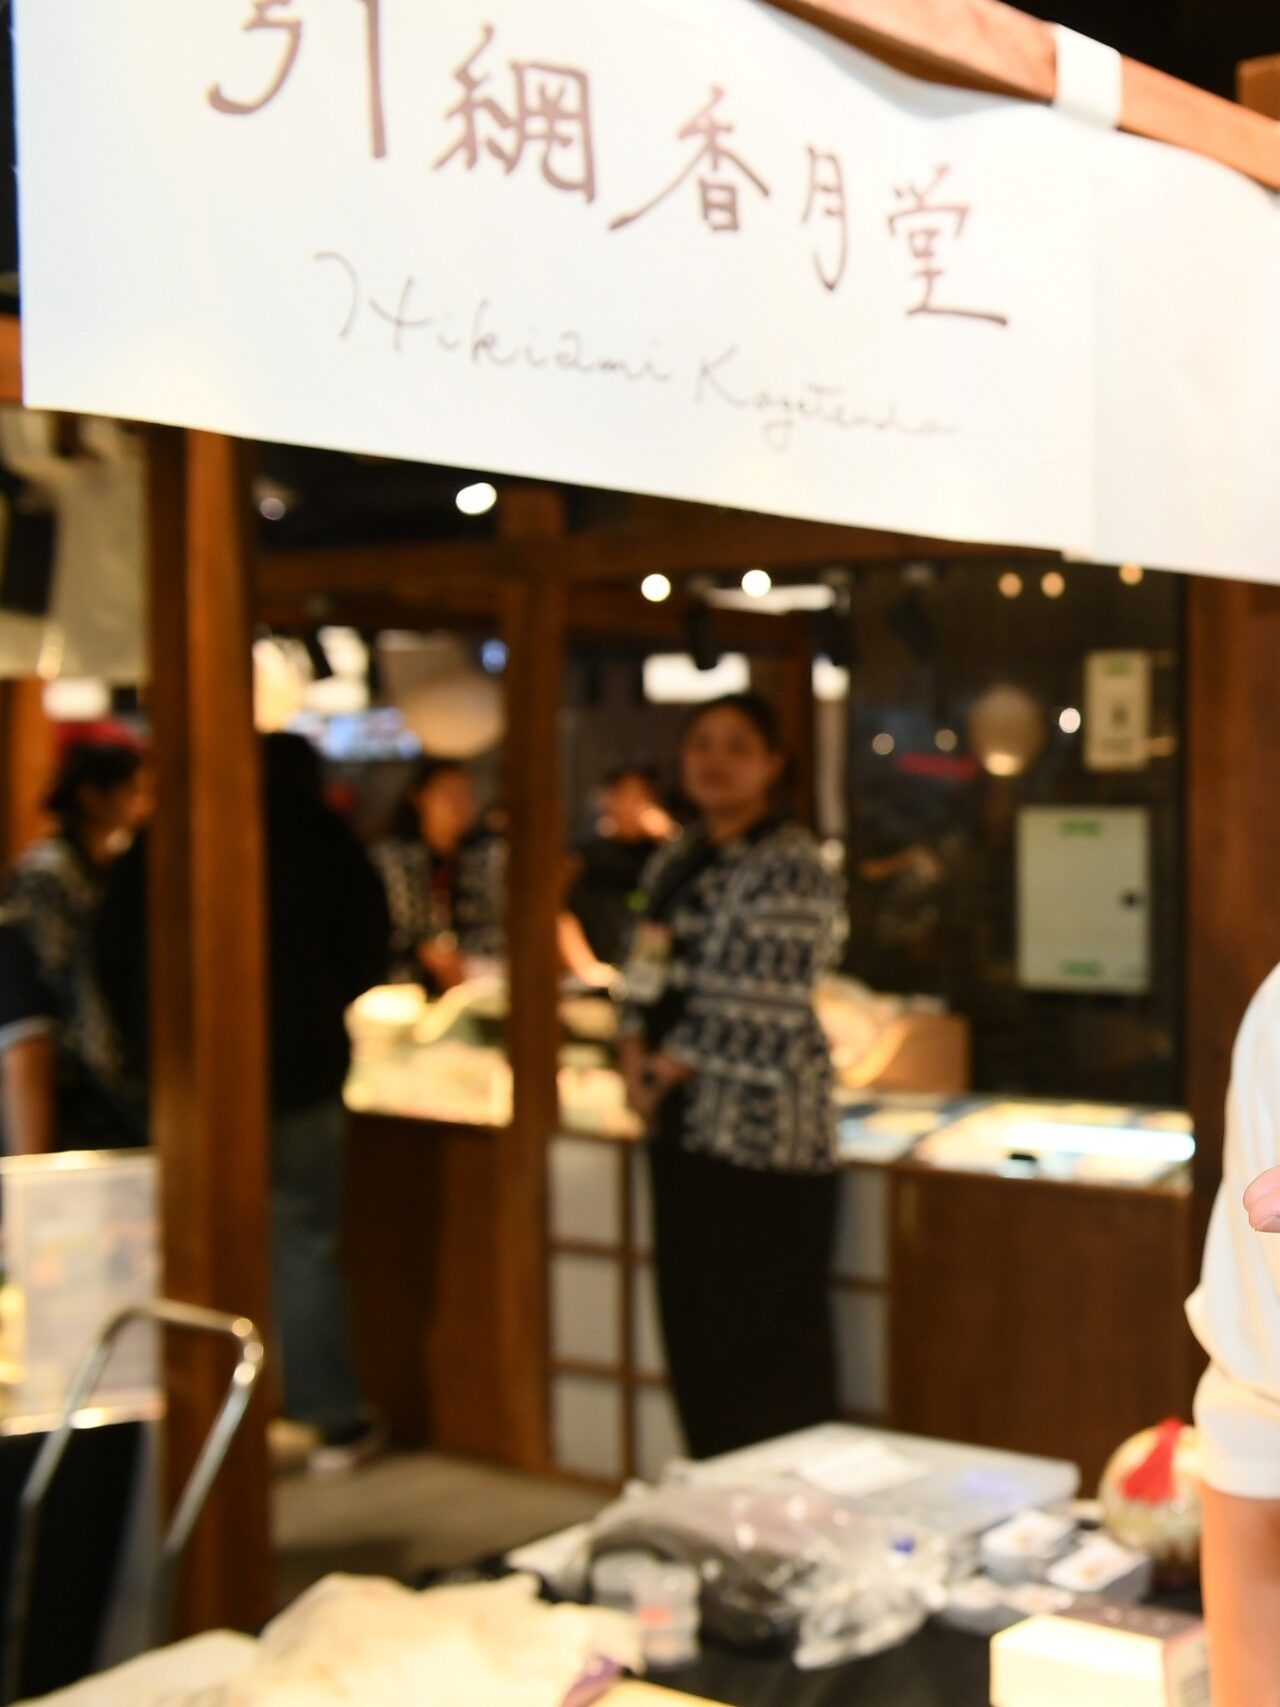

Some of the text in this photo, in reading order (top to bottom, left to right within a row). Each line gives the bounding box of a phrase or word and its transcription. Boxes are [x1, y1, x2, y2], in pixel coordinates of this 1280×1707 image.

[205, 0, 1009, 328] 引網香月堂
[311, 250, 674, 384] Hikiami
